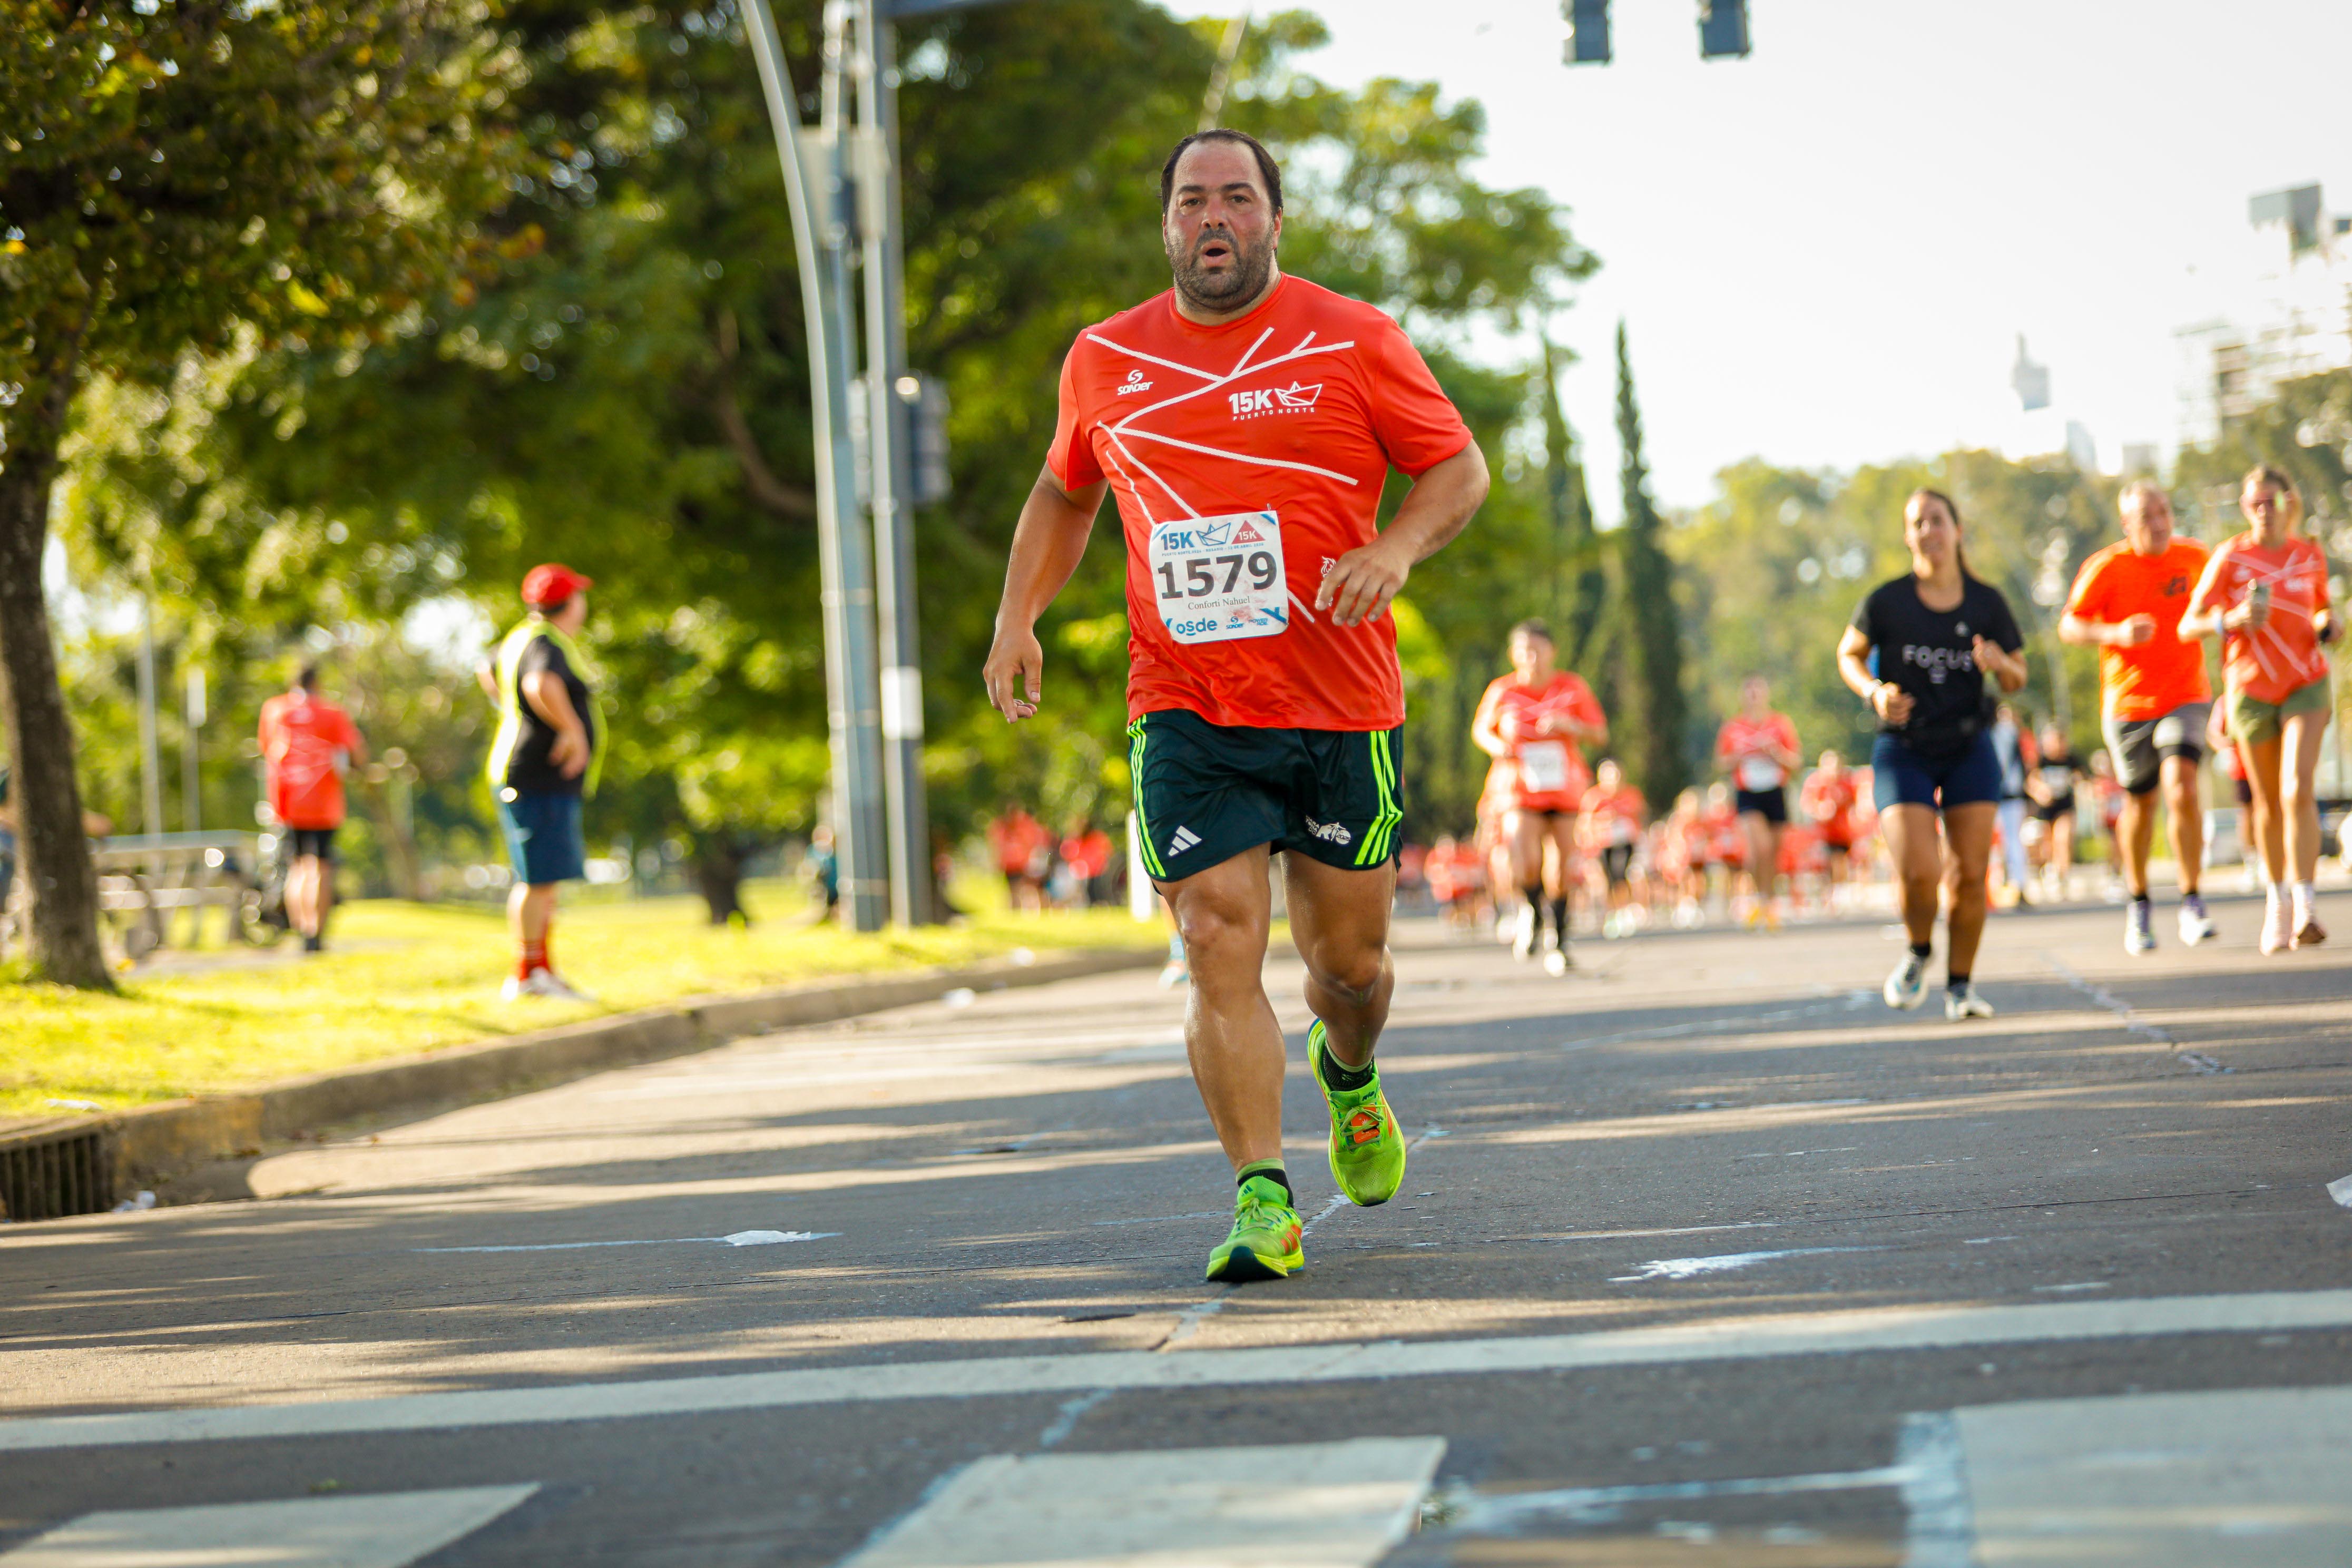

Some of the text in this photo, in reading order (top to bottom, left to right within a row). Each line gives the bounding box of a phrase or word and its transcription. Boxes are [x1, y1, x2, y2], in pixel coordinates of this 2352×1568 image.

[1229, 389, 1273, 414] 15K
[1233, 407, 1316, 421] PUERTO NORTE
[1161, 531, 1196, 551] 15K
[1238, 530, 1257, 541] 15K
[1158, 551, 1277, 600] 1579
[1188, 596, 1250, 610] Conforti Nahuel
[1176, 618, 1218, 635] osde
[1901, 644, 1973, 672] FOCUS
